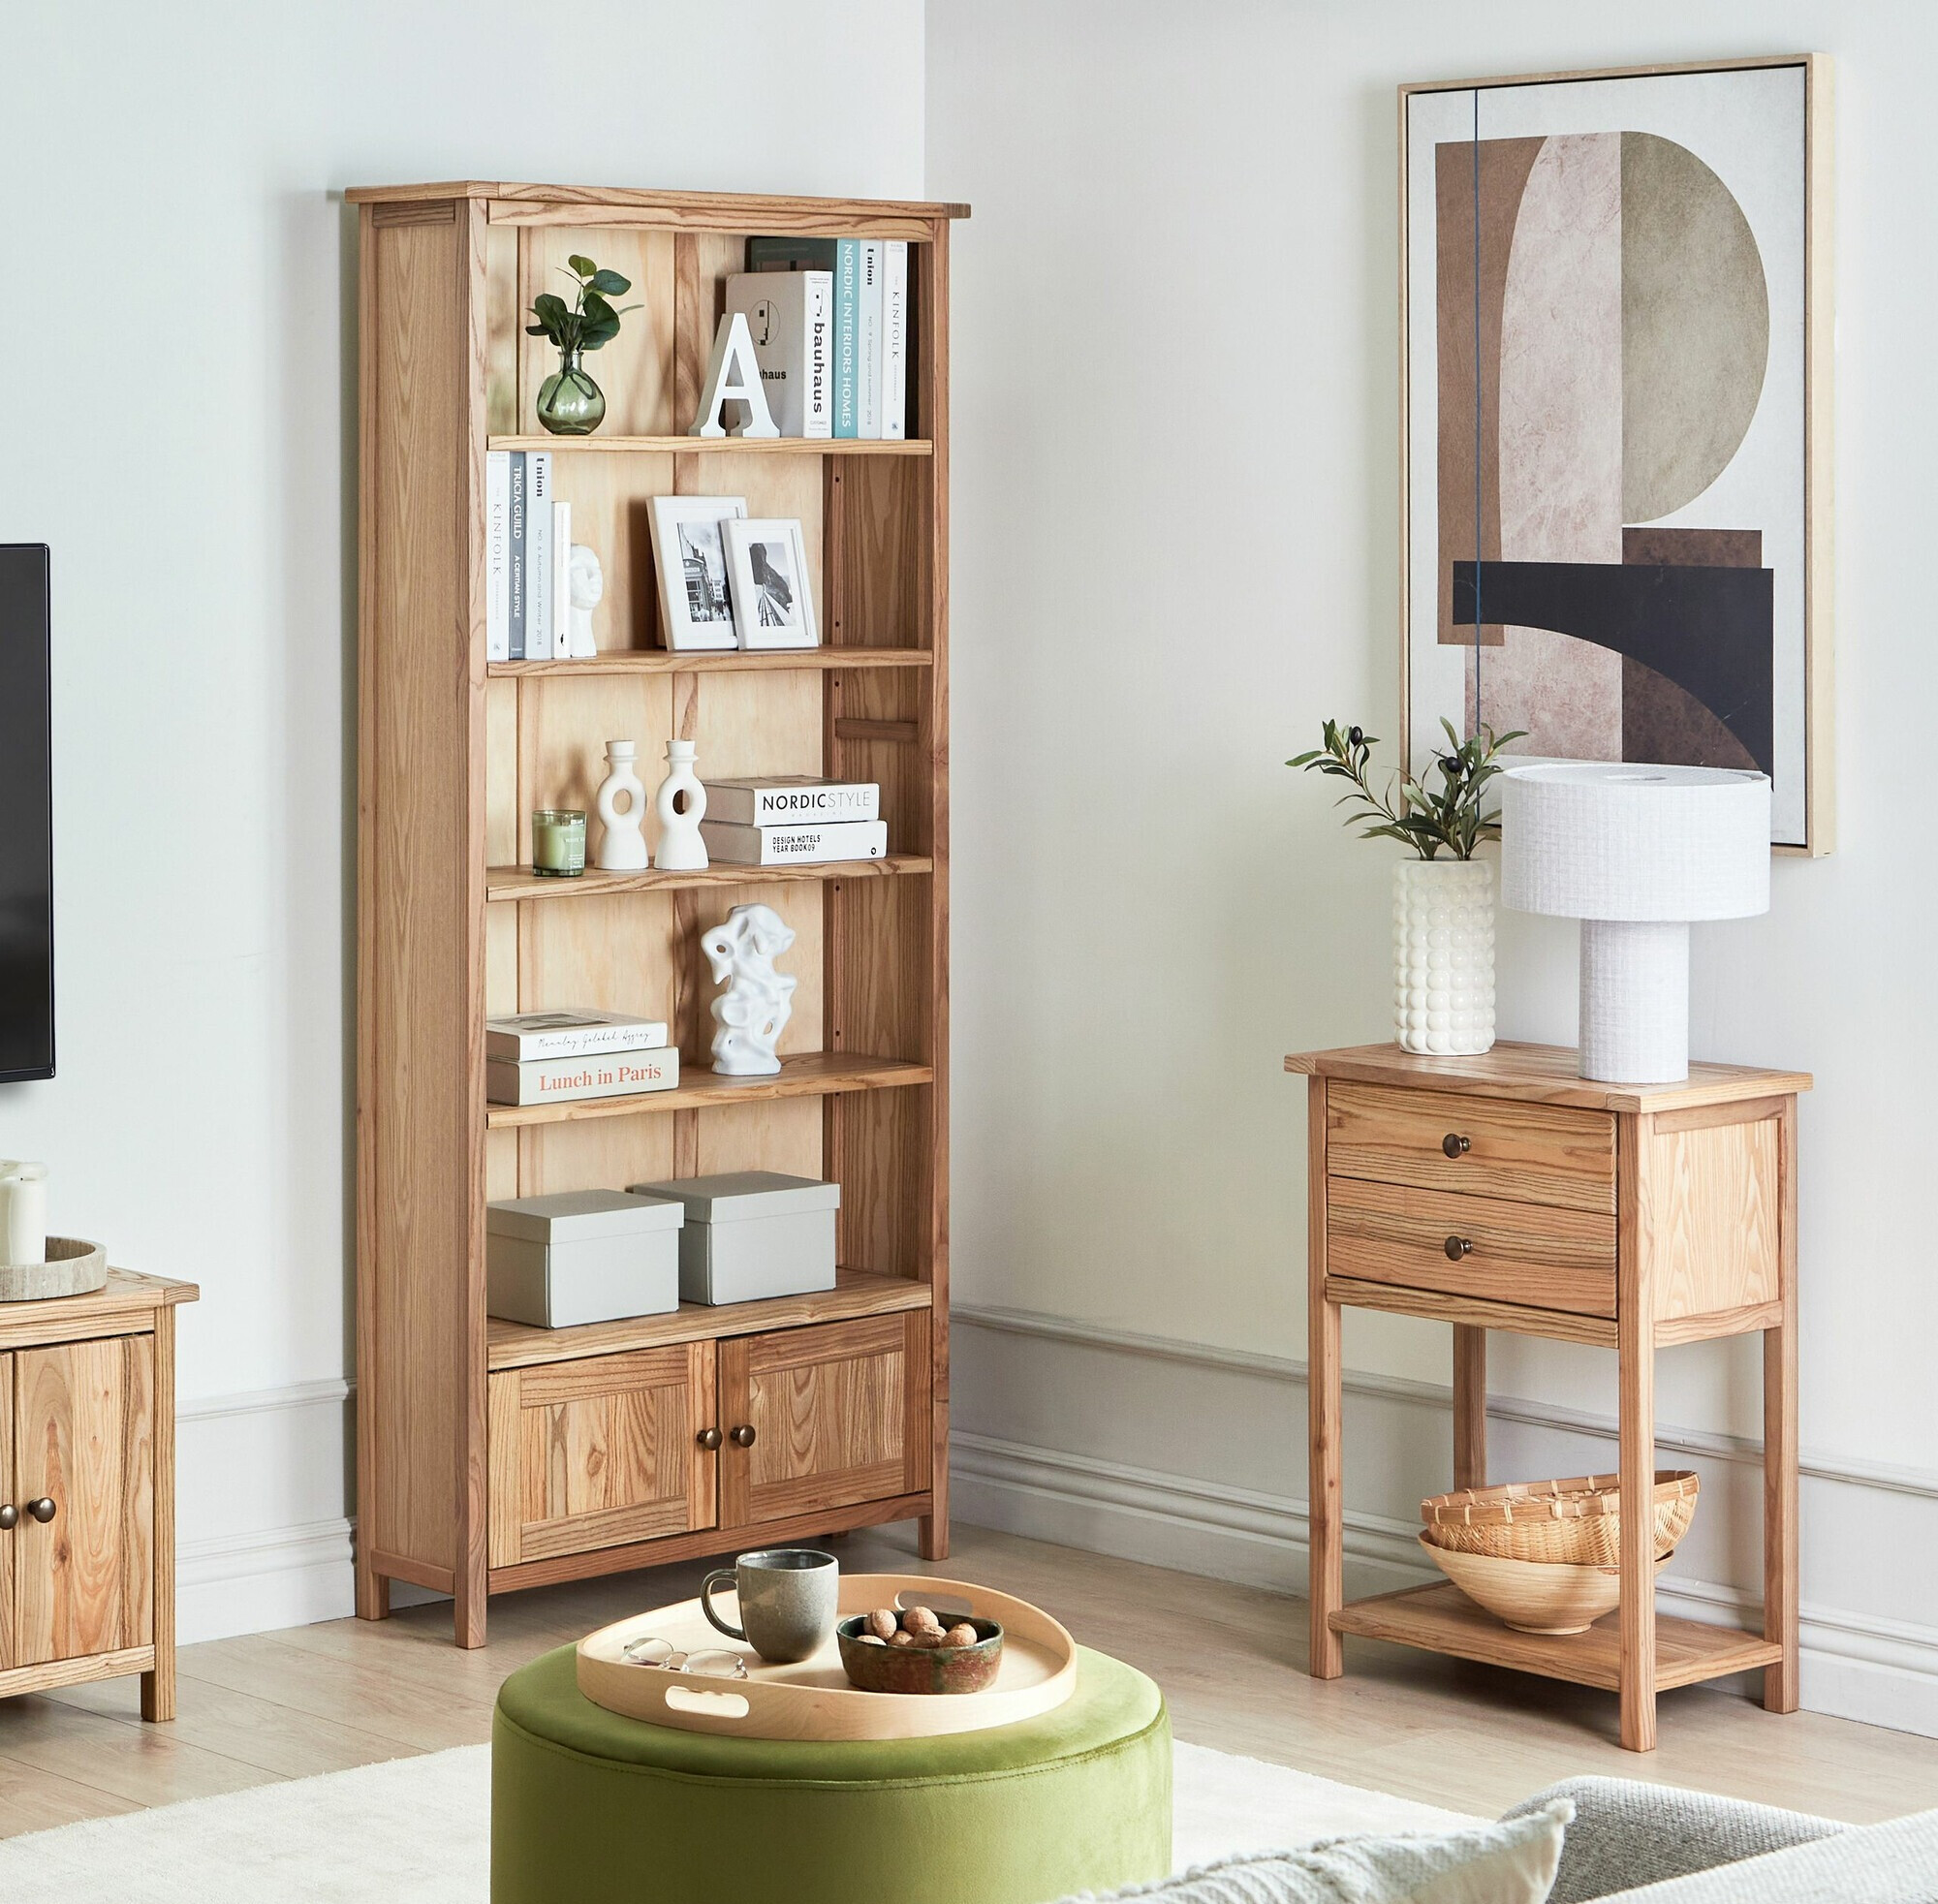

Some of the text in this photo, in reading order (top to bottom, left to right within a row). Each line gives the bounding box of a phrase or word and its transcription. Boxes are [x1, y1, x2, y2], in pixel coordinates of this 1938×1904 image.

[866, 248, 875, 286] Union
[841, 244, 854, 427] NORDIC INTERIORS HOMES
[891, 291, 900, 359] KINFOLK
[759, 368, 787, 380] haus
[813, 322, 826, 414] bauhaus
[514, 465, 522, 503] TRICIA
[536, 457, 545, 497] Union
[492, 503, 502, 575] KINFOLK
[514, 504, 522, 539] GUILD
[772, 834, 821, 845] DESIGN HOTELS
[772, 844, 789, 853] YEAR
[539, 1063, 662, 1092] Lunch in Paris
